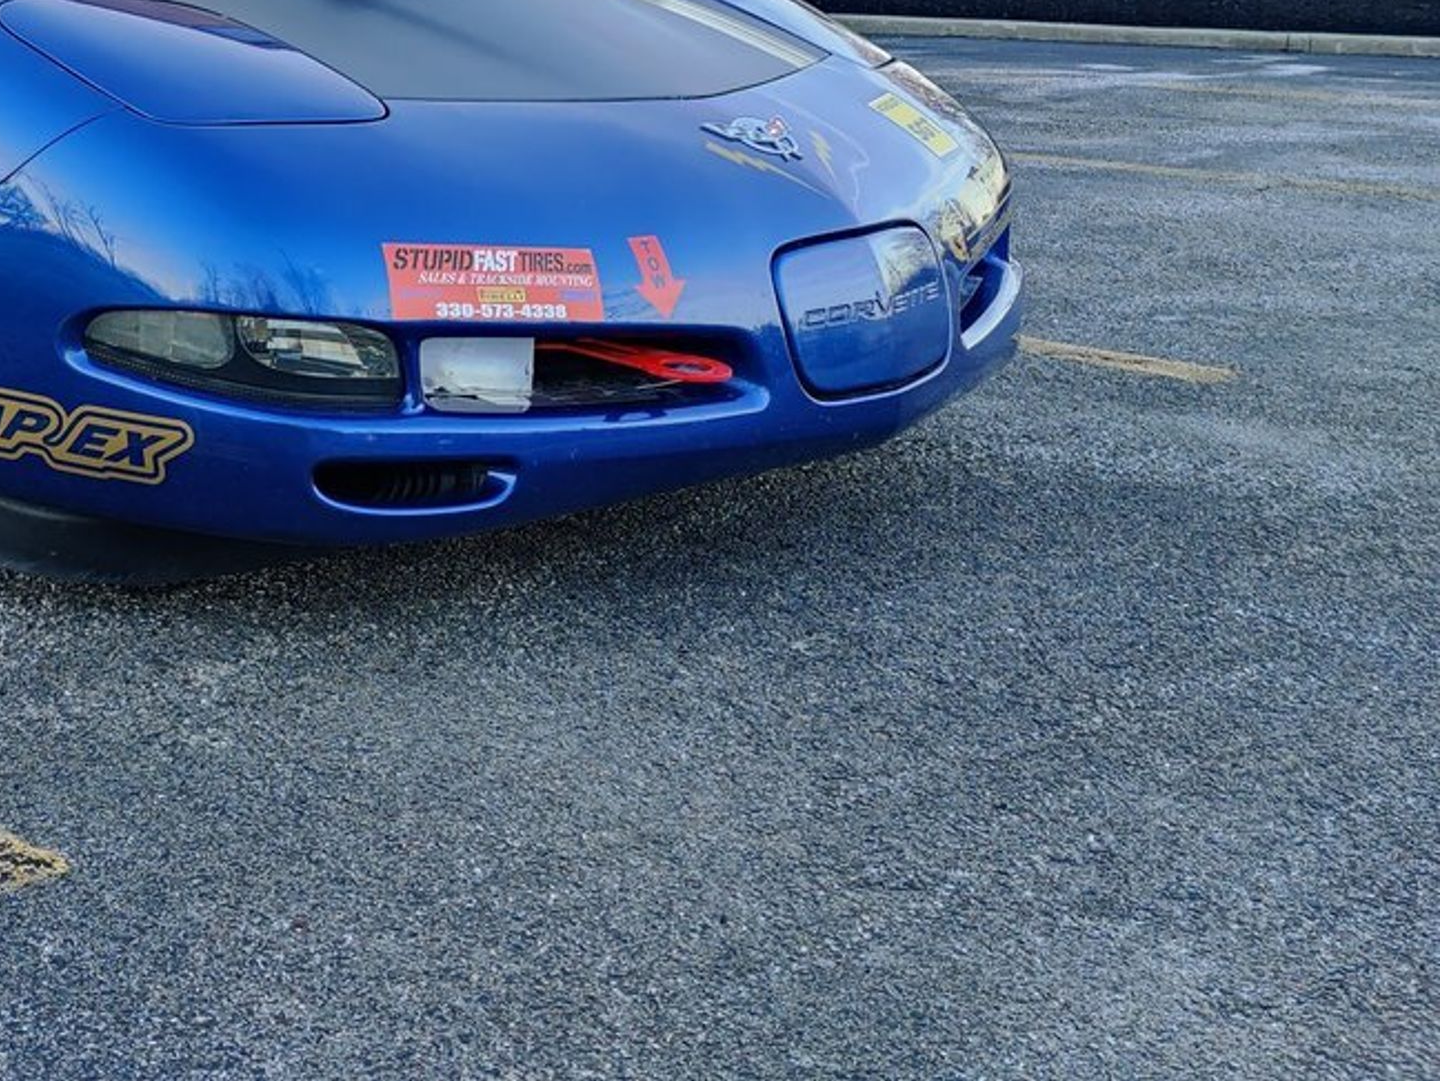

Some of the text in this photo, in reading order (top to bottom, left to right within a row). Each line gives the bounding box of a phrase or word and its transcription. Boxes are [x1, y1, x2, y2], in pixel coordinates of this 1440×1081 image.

[393, 247, 593, 274] STUPIDFASTTIRES.com
[640, 240, 667, 290] TOW
[417, 270, 457, 285] SALES
[534, 273, 594, 288] MOUNTING
[435, 301, 568, 319] 330-573-4338
[800, 279, 941, 331] CORVETTE
